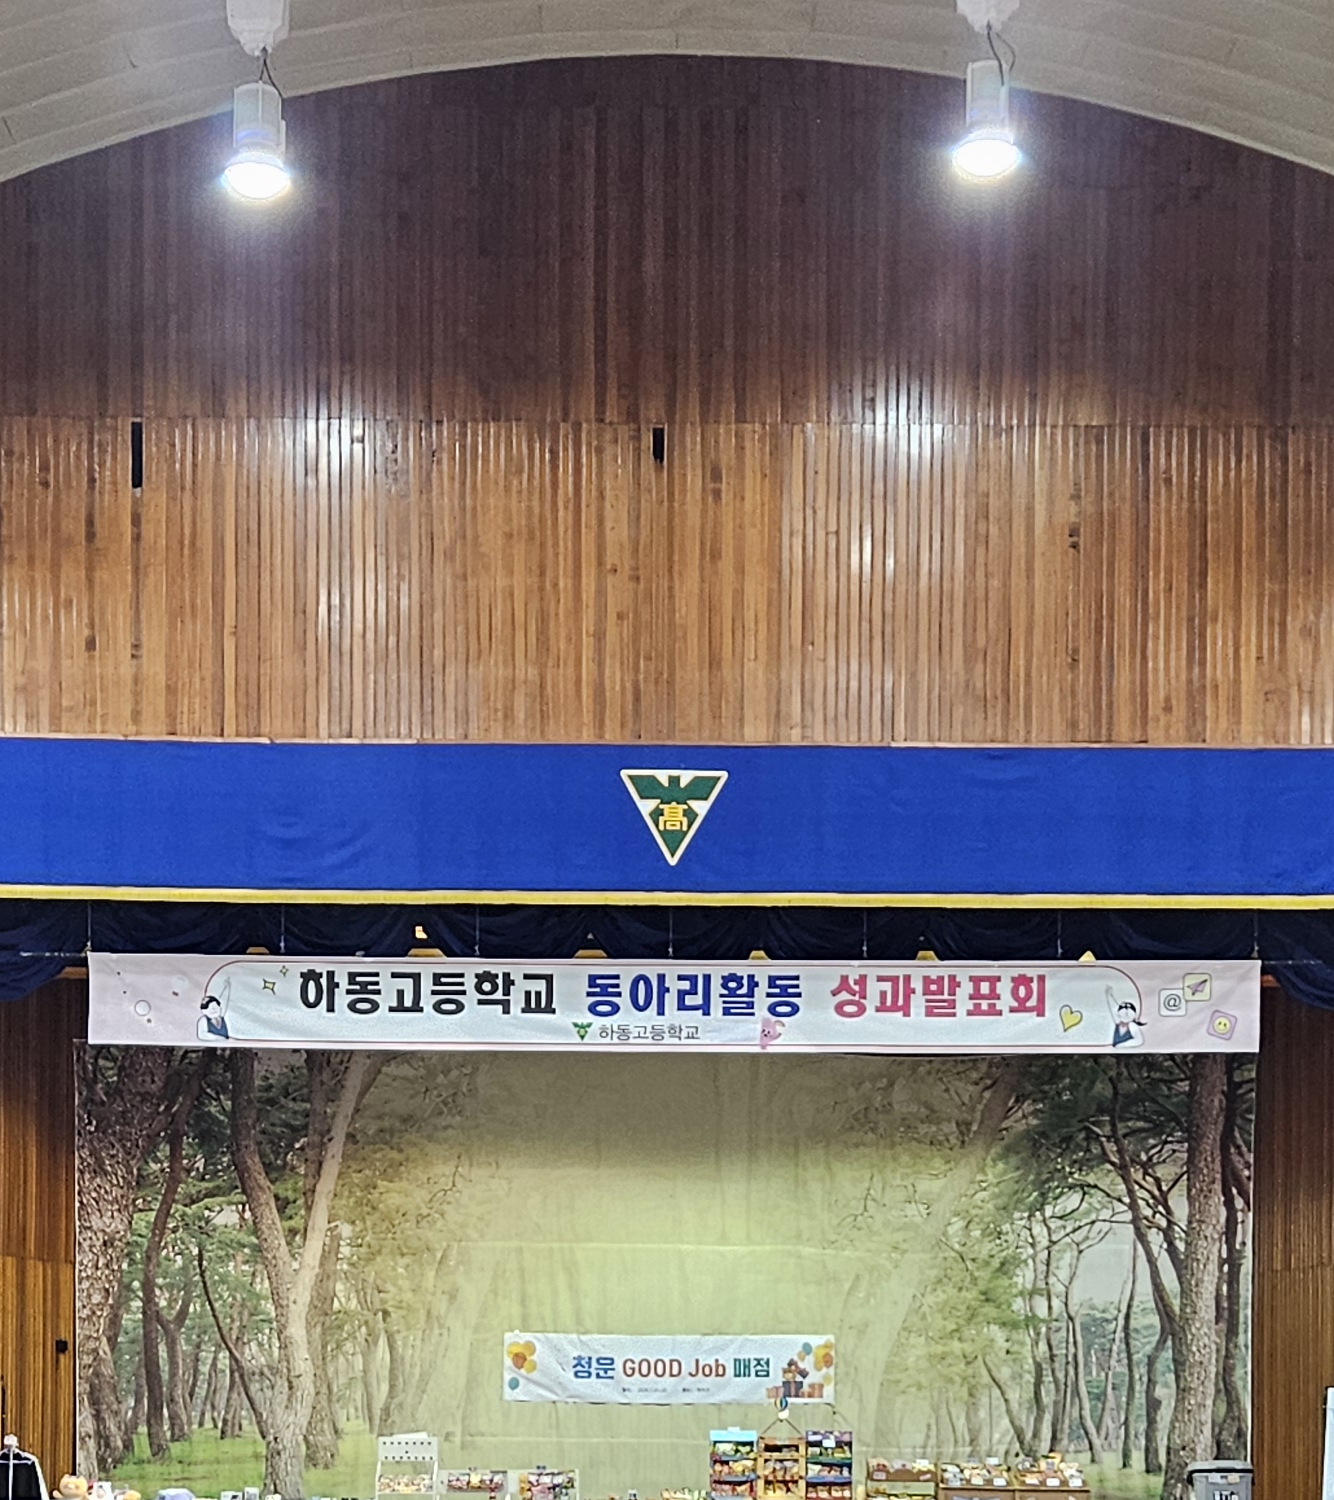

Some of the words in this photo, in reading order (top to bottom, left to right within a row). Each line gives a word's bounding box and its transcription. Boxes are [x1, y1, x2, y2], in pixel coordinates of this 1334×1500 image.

[299, 968, 557, 1016] 하동고등학교
[585, 972, 803, 1018] 동아리활동
[829, 972, 1047, 1019] 성과발표회
[597, 1023, 701, 1042] 하동고등학교
[571, 1355, 616, 1380] 청운
[622, 1357, 683, 1379] GOOD
[687, 1357, 727, 1379] Job
[733, 1356, 771, 1379] 매점
